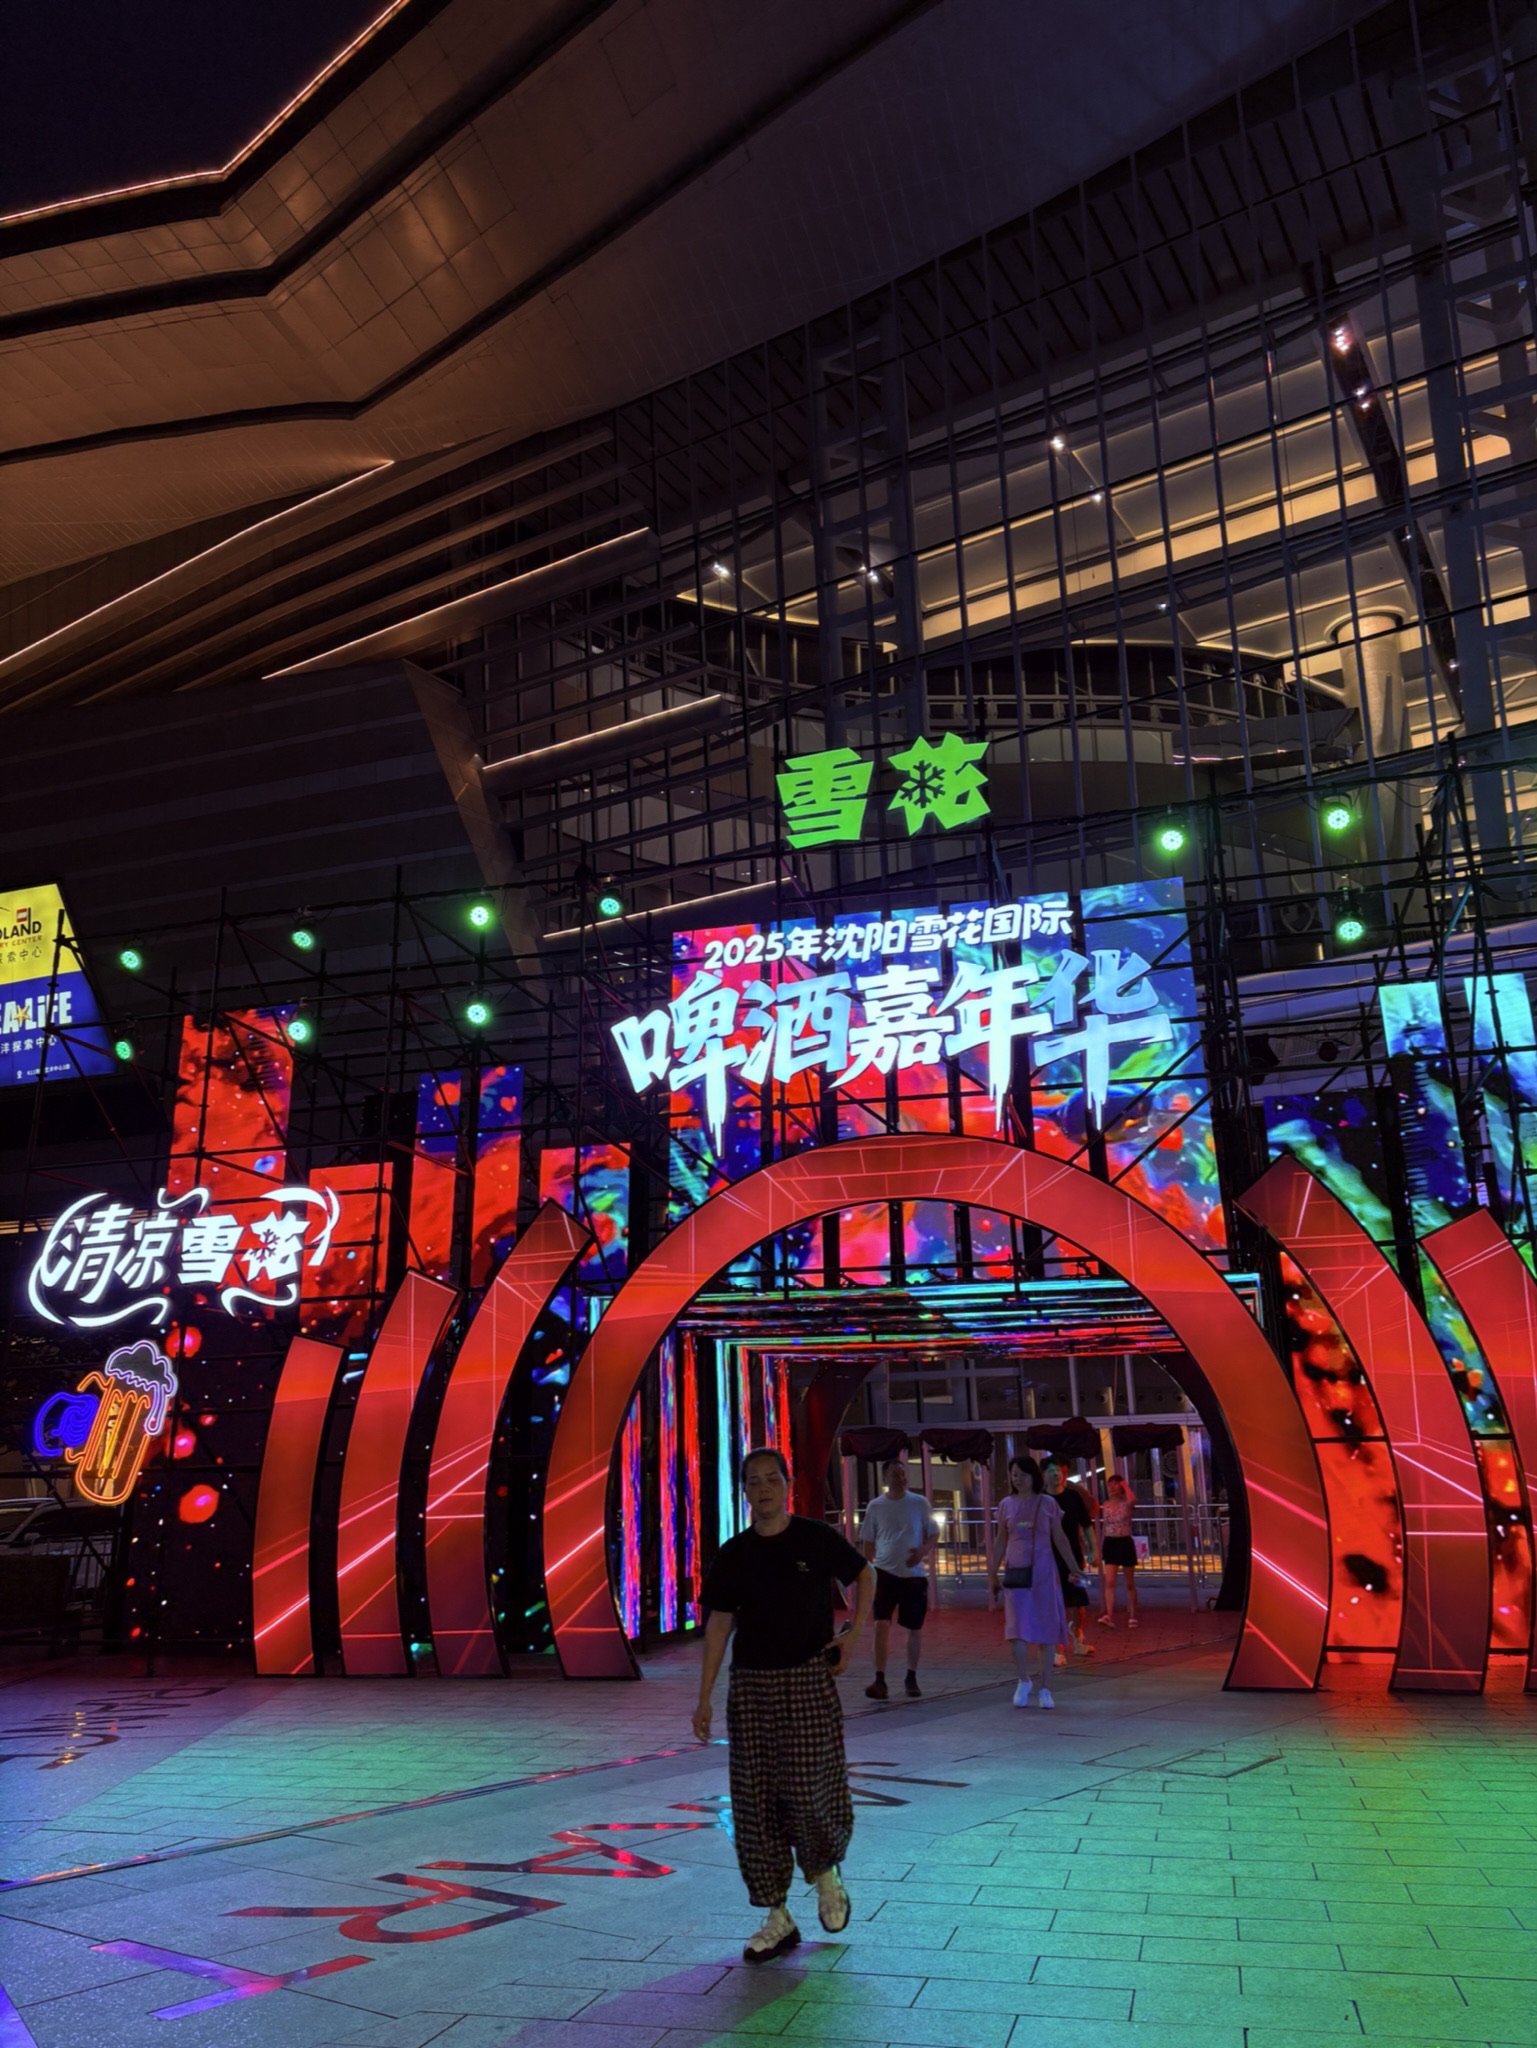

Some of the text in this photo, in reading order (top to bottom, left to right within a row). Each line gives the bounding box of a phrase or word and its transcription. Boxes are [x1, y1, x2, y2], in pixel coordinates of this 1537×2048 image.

[776, 732, 992, 849] 雪花
[12, 934, 42, 947] CENTER
[704, 899, 1075, 970] 2025年沈阳雪花国际
[610, 948, 1174, 1157] 啤酒嘉年华
[40, 1202, 312, 1304] 清凉雪花
